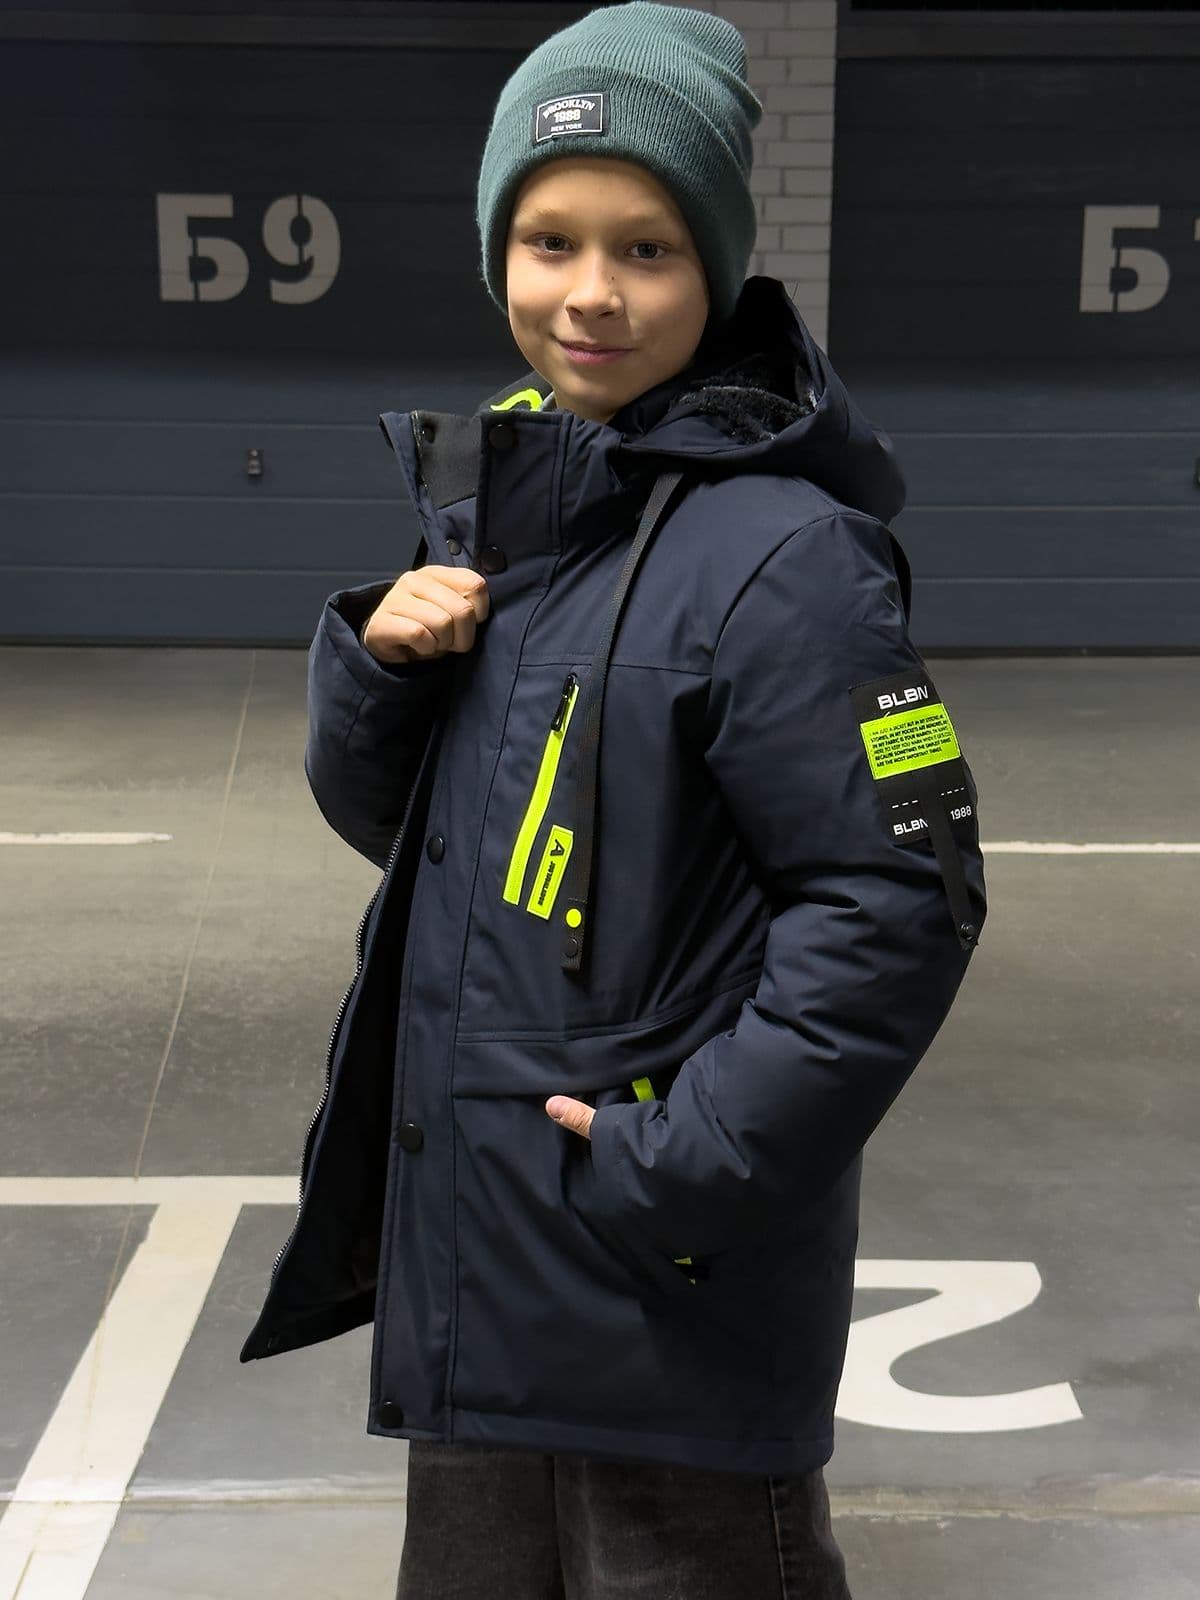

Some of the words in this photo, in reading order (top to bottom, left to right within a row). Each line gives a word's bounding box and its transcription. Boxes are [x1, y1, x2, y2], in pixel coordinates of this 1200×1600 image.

[542, 99, 596, 119] BROOKLYN
[157, 194, 341, 304] Б9
[1079, 205, 1200, 313] Б
[950, 805, 972, 821] 1988
